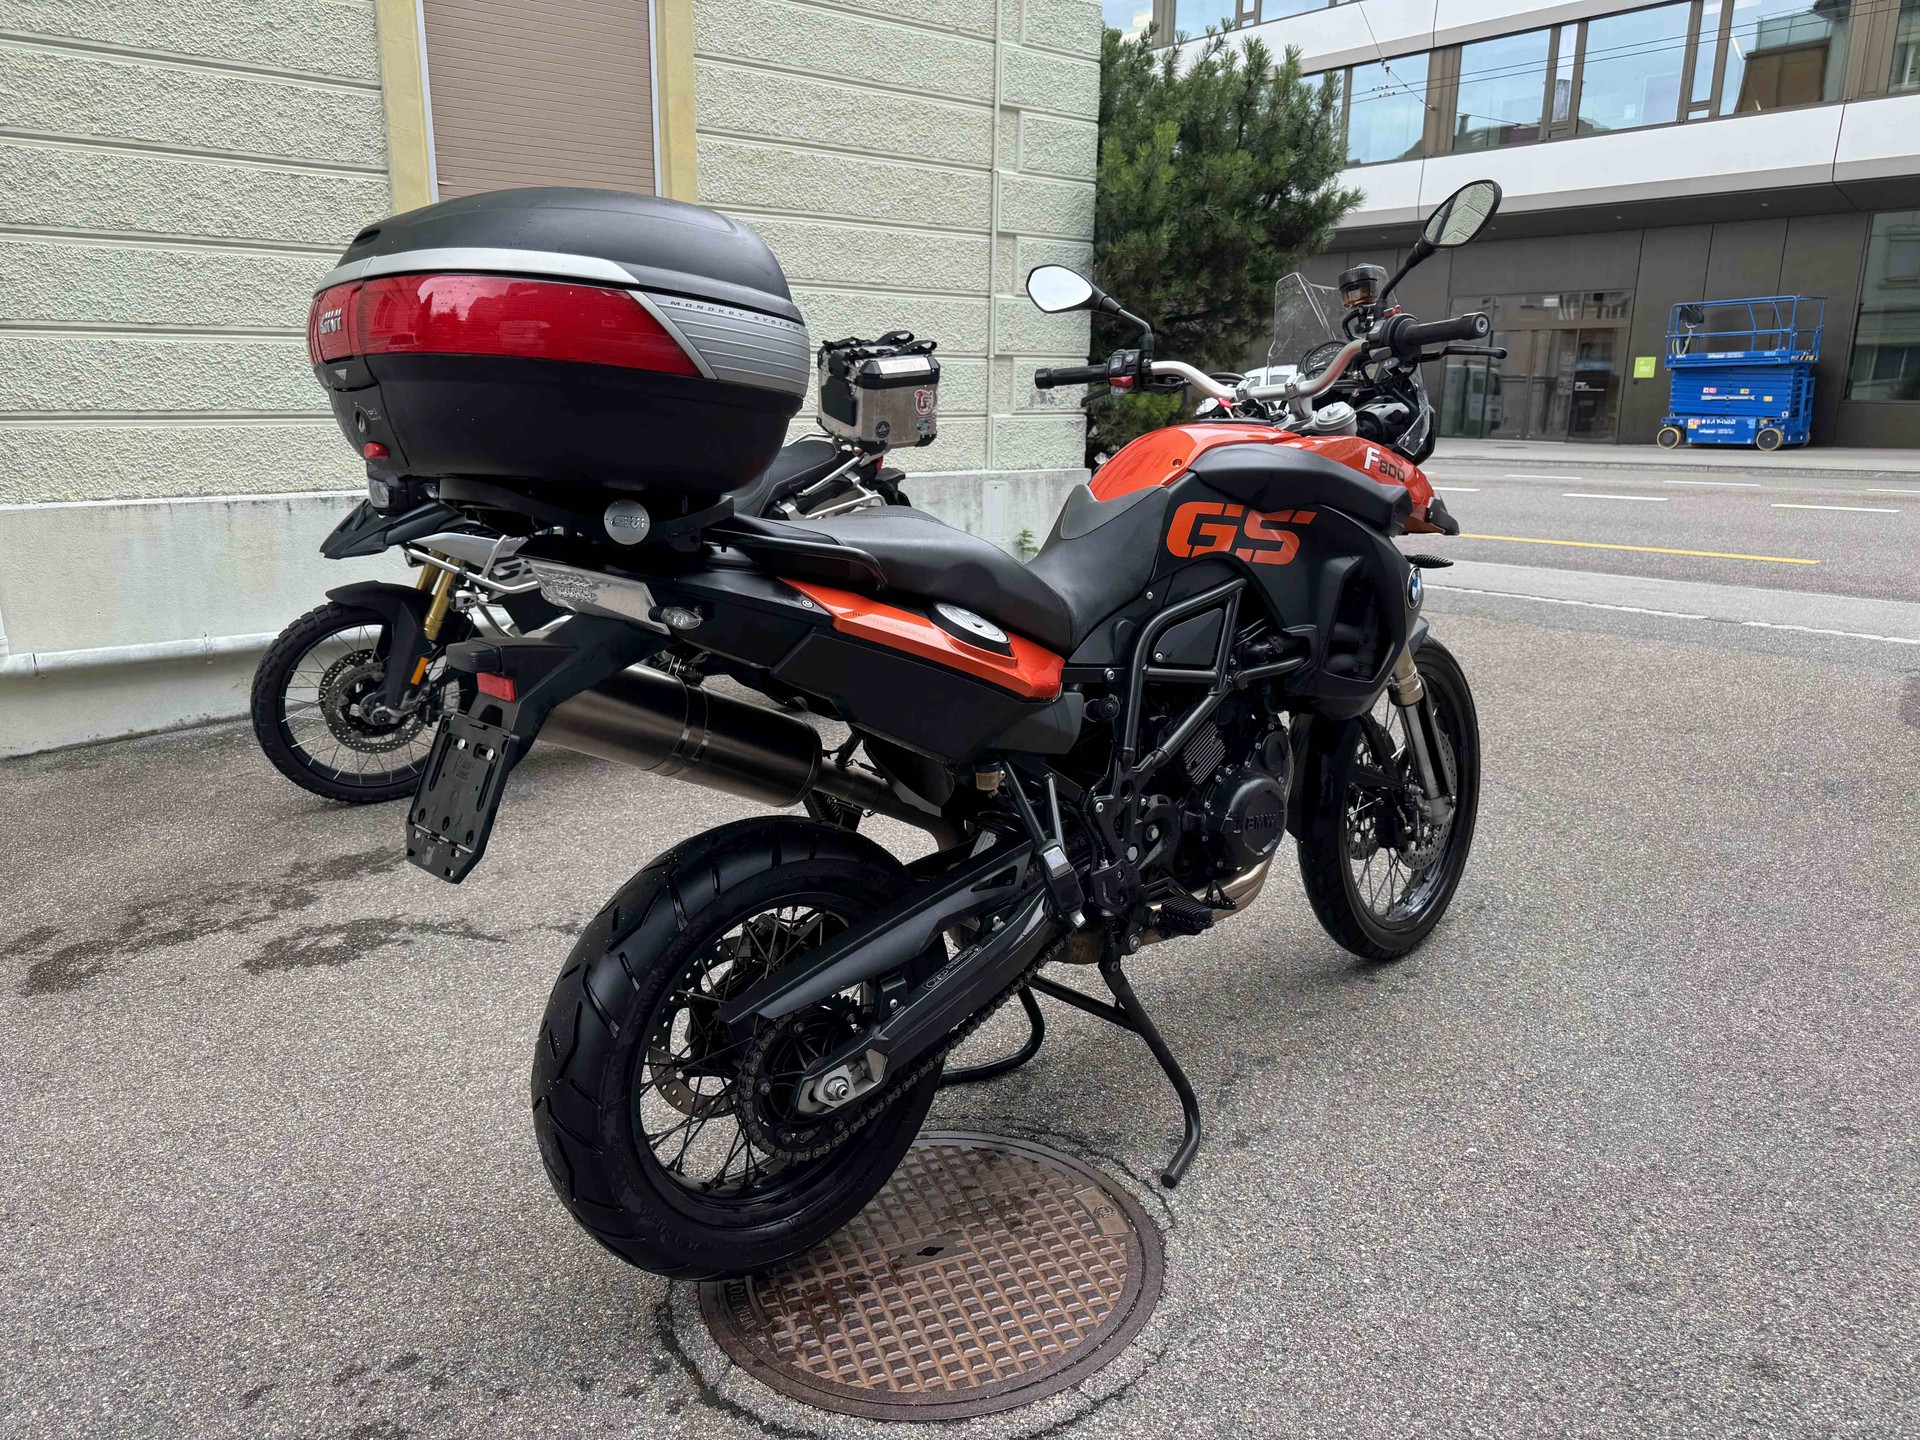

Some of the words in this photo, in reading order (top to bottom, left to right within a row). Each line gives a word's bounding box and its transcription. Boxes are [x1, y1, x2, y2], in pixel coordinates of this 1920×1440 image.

[670, 301, 744, 317] MONOKEY
[753, 315, 800, 330] SYSTEM
[1363, 446, 1380, 470] F
[1379, 460, 1405, 482] 800
[610, 515, 645, 529] GIVI
[1166, 501, 1317, 565] GS
[1246, 813, 1277, 830] BMW
